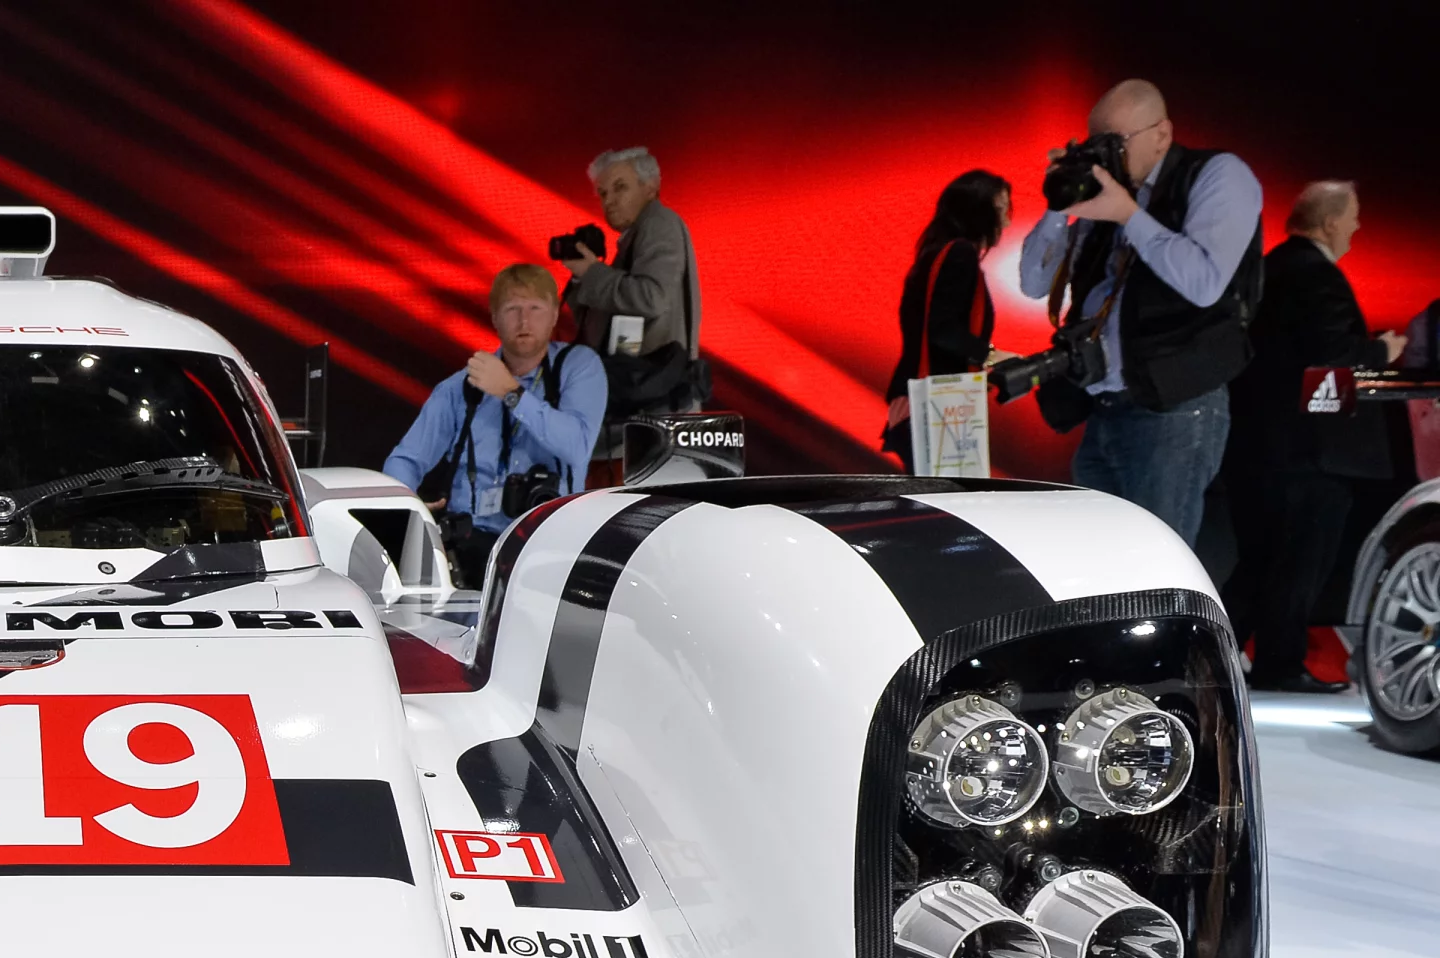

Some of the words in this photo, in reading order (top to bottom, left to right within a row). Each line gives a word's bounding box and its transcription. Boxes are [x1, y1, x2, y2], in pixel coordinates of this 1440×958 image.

[677, 431, 744, 447] CHOPARD
[5, 610, 364, 632] MORI
[451, 834, 546, 877] P1
